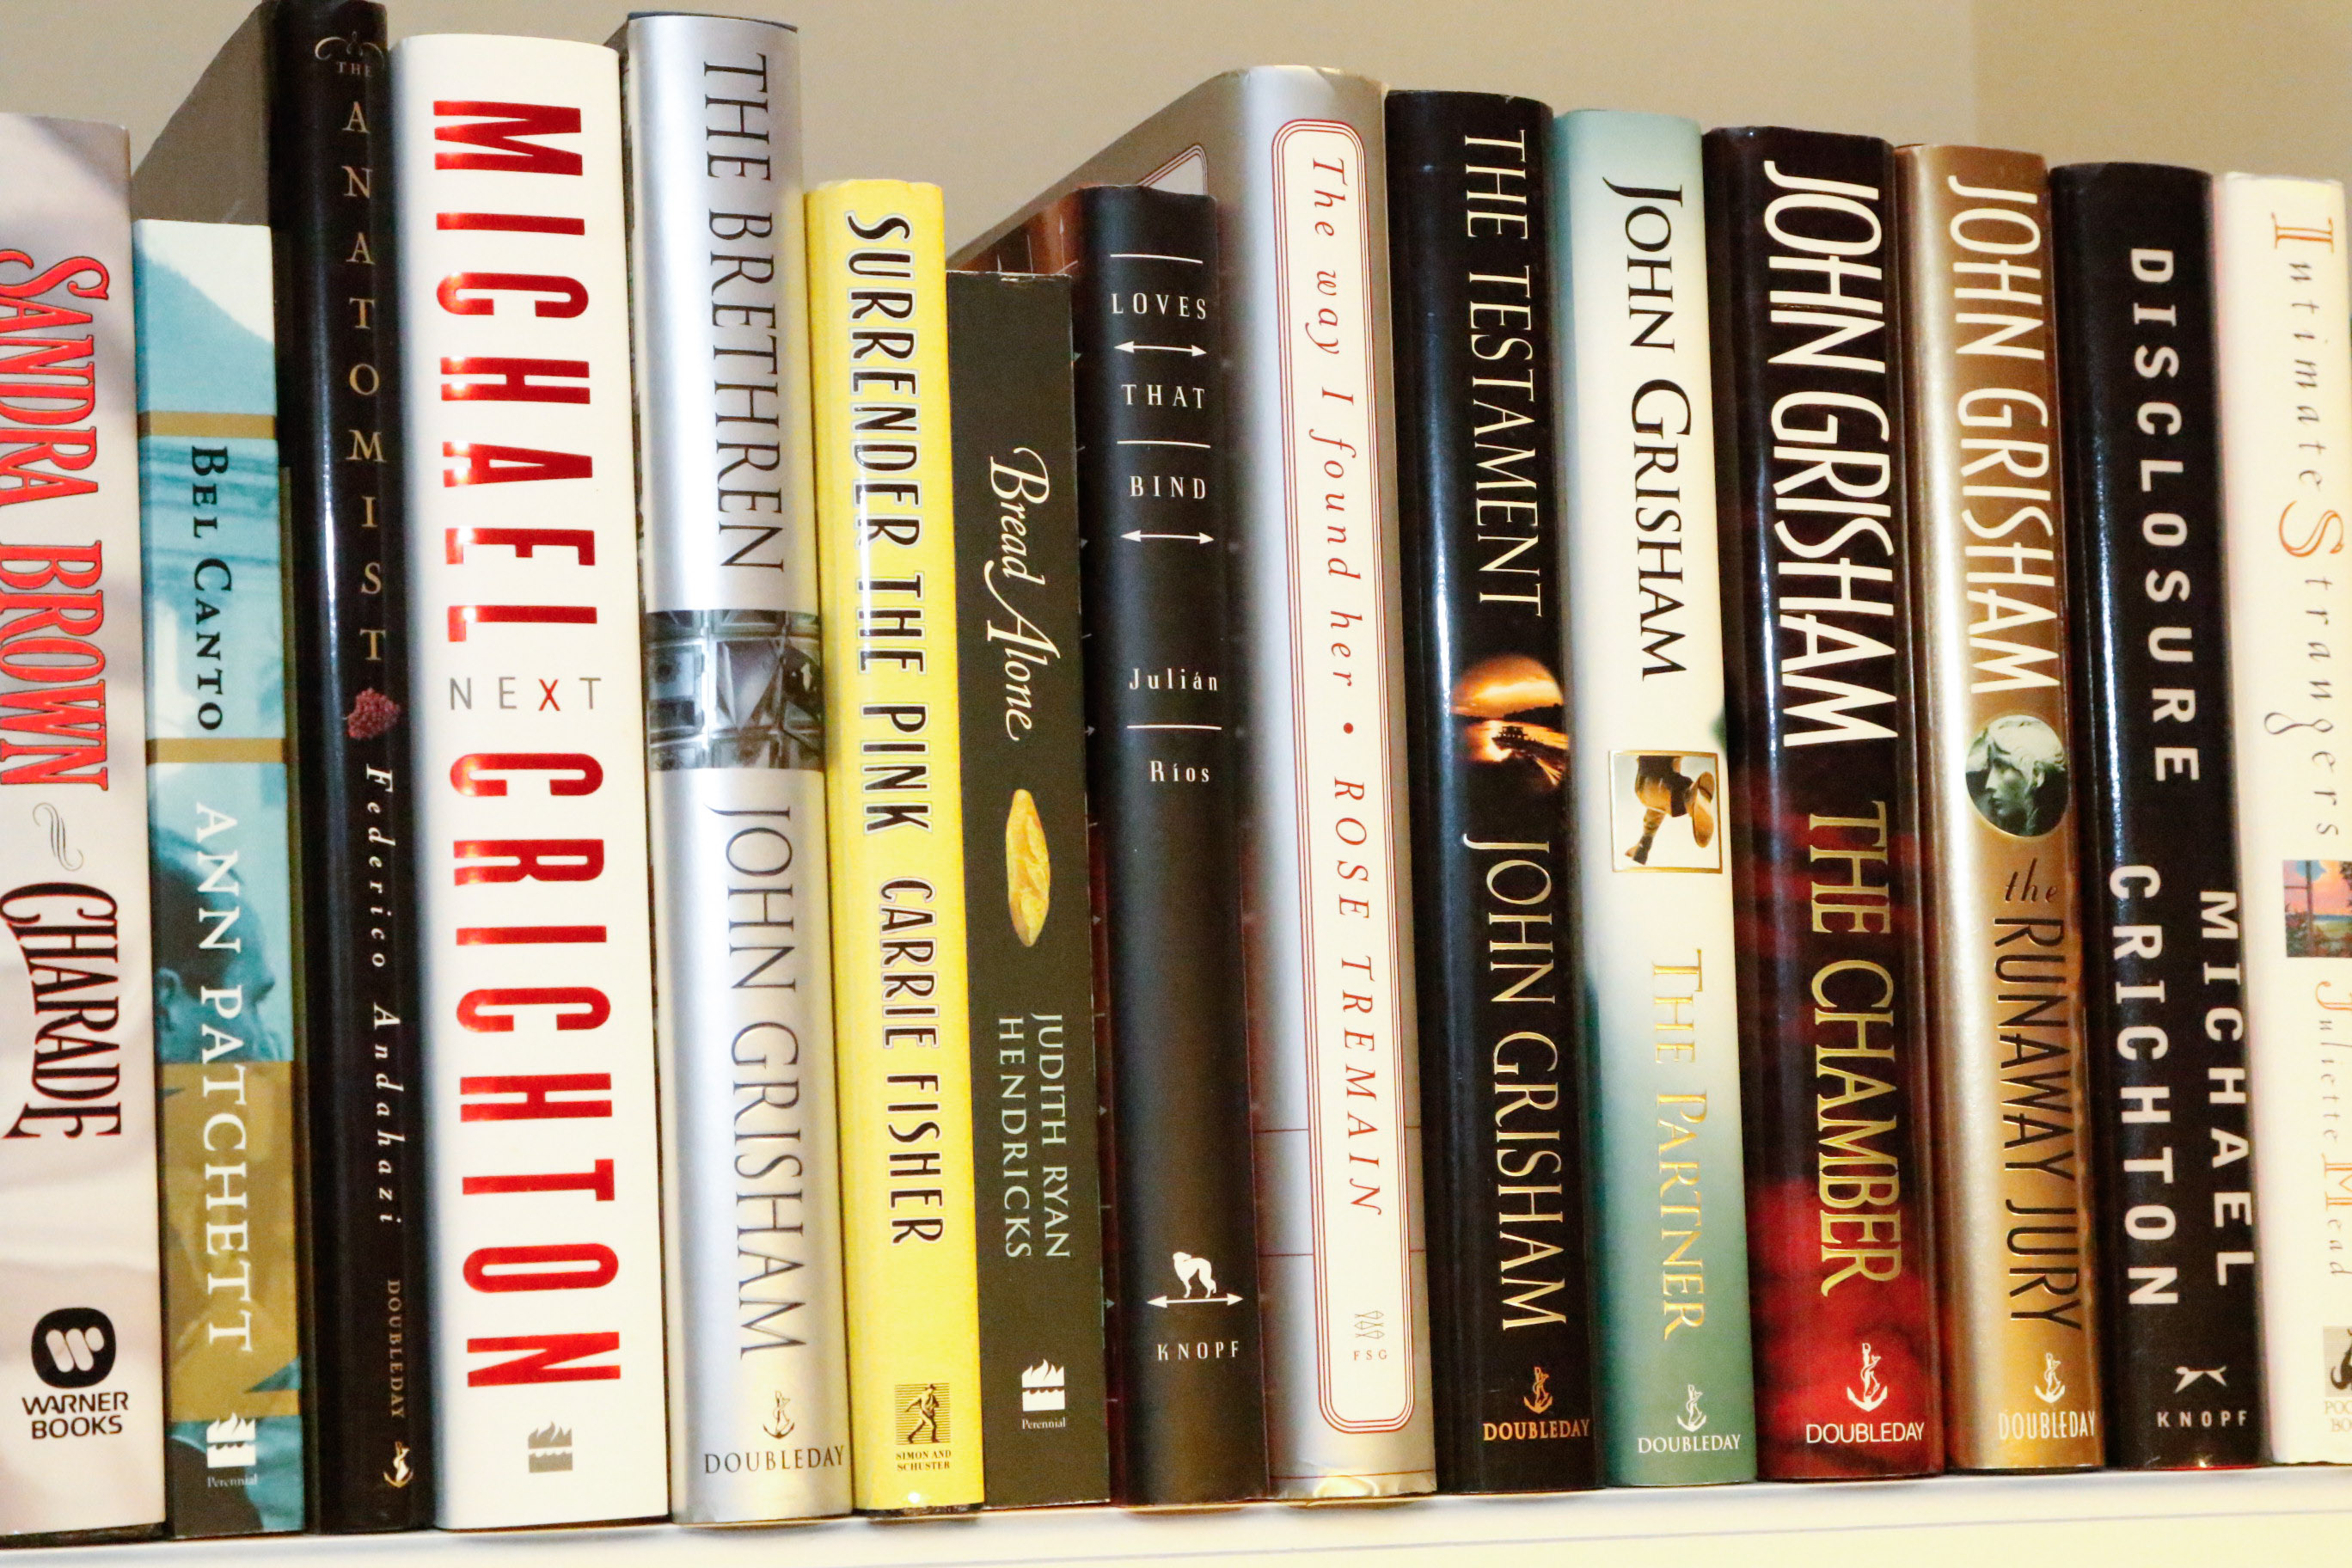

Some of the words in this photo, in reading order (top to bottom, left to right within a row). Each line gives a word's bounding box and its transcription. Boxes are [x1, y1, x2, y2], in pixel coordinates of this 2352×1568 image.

[336, 61, 372, 77] THE
[704, 52, 772, 181] THE
[1311, 156, 1349, 239] The
[1463, 128, 1530, 241] THE
[1111, 292, 1207, 320] LOVES
[1305, 269, 1355, 356] way
[1602, 175, 1683, 354] JOHN
[1763, 160, 1886, 374] JOHN
[1948, 175, 2045, 360] JOHN
[0, 249, 109, 505] SANDRA
[342, 101, 386, 662] ANATOMIST
[433, 100, 597, 643] MICHAEL
[708, 208, 785, 572] BRETHREN
[844, 208, 923, 549] SURRENDER
[1121, 383, 1205, 410] THAT
[1320, 386, 1354, 407] I
[2269, 211, 2335, 487] Intimate
[191, 446, 229, 538] BEL
[1130, 475, 1207, 500] BIND
[1309, 427, 1361, 579] found
[1468, 263, 1542, 618] TESTAMENT
[989, 446, 1050, 588] Bread
[1631, 379, 1692, 682] GRISHAM
[1770, 390, 1898, 747] GRISHAM
[1957, 387, 2060, 695] GRISHAM
[2130, 247, 2200, 783] DISCLOSURE
[0, 540, 108, 791] BROWN
[191, 559, 232, 732] CANTO
[450, 677, 603, 713] NEXT
[857, 573, 926, 676] THE
[984, 559, 1061, 744] Alone
[1128, 668, 1219, 693] Julián
[1328, 606, 1365, 688] her
[2264, 501, 2344, 837] Strangers
[861, 702, 934, 837] PINK
[1148, 759, 1211, 784] Ríos
[195, 803, 241, 954] ANN
[365, 764, 396, 968] Federico
[704, 801, 796, 992] JOHN
[1332, 775, 1370, 921] ROSE
[1463, 832, 1557, 1006] JOHN
[1809, 799, 1890, 935] THE
[2004, 857, 2059, 905] the
[0, 881, 122, 1140] CHARADE
[879, 875, 940, 1050] CARRIE
[1651, 947, 1704, 1064] THE
[373, 1004, 405, 1223] Andahazi
[449, 753, 621, 1388] CRICHTON
[1032, 1013, 1068, 1147] JUDITH
[1339, 955, 1383, 1217] TREMAIN
[1994, 917, 2075, 1182] RUNAWAY
[2109, 864, 2178, 1305] CRICHTON
[2199, 889, 2255, 1287] MICHAEL
[199, 986, 253, 1352] PATCHETT
[730, 1021, 808, 1362] GRISHAM
[885, 1073, 945, 1246] FISHER
[998, 1015, 1032, 1260] HENDRICKS
[1491, 1032, 1567, 1331] GRISHAM
[1810, 959, 1902, 1297] CHAMBER
[1041, 1165, 1071, 1260] RYAN
[1655, 1089, 1709, 1342] PARTNER
[2004, 1198, 2081, 1332] JURY
[21, 1391, 128, 1415] WARNER
[387, 1278, 407, 1419] DOUBLEDAY
[1156, 1339, 1240, 1362] KNOPF
[2156, 1409, 2247, 1429] KNOPF
[32, 1415, 123, 1440] BOOKS
[207, 1474, 257, 1488] Perennial
[704, 1446, 845, 1475] DOUBLEDAY
[896, 1451, 928, 1461] SIMON
[934, 1449, 952, 1459] AND
[897, 1461, 950, 1472] SCHUSTER
[1021, 1417, 1066, 1430] Perennial
[1483, 1418, 1590, 1442] DOUBLEDAY
[1638, 1433, 1741, 1455] DOUBLEDAY
[1806, 1421, 1925, 1444] DOUBLEDAY
[1998, 1409, 2096, 1439] DOUBLEDAY
